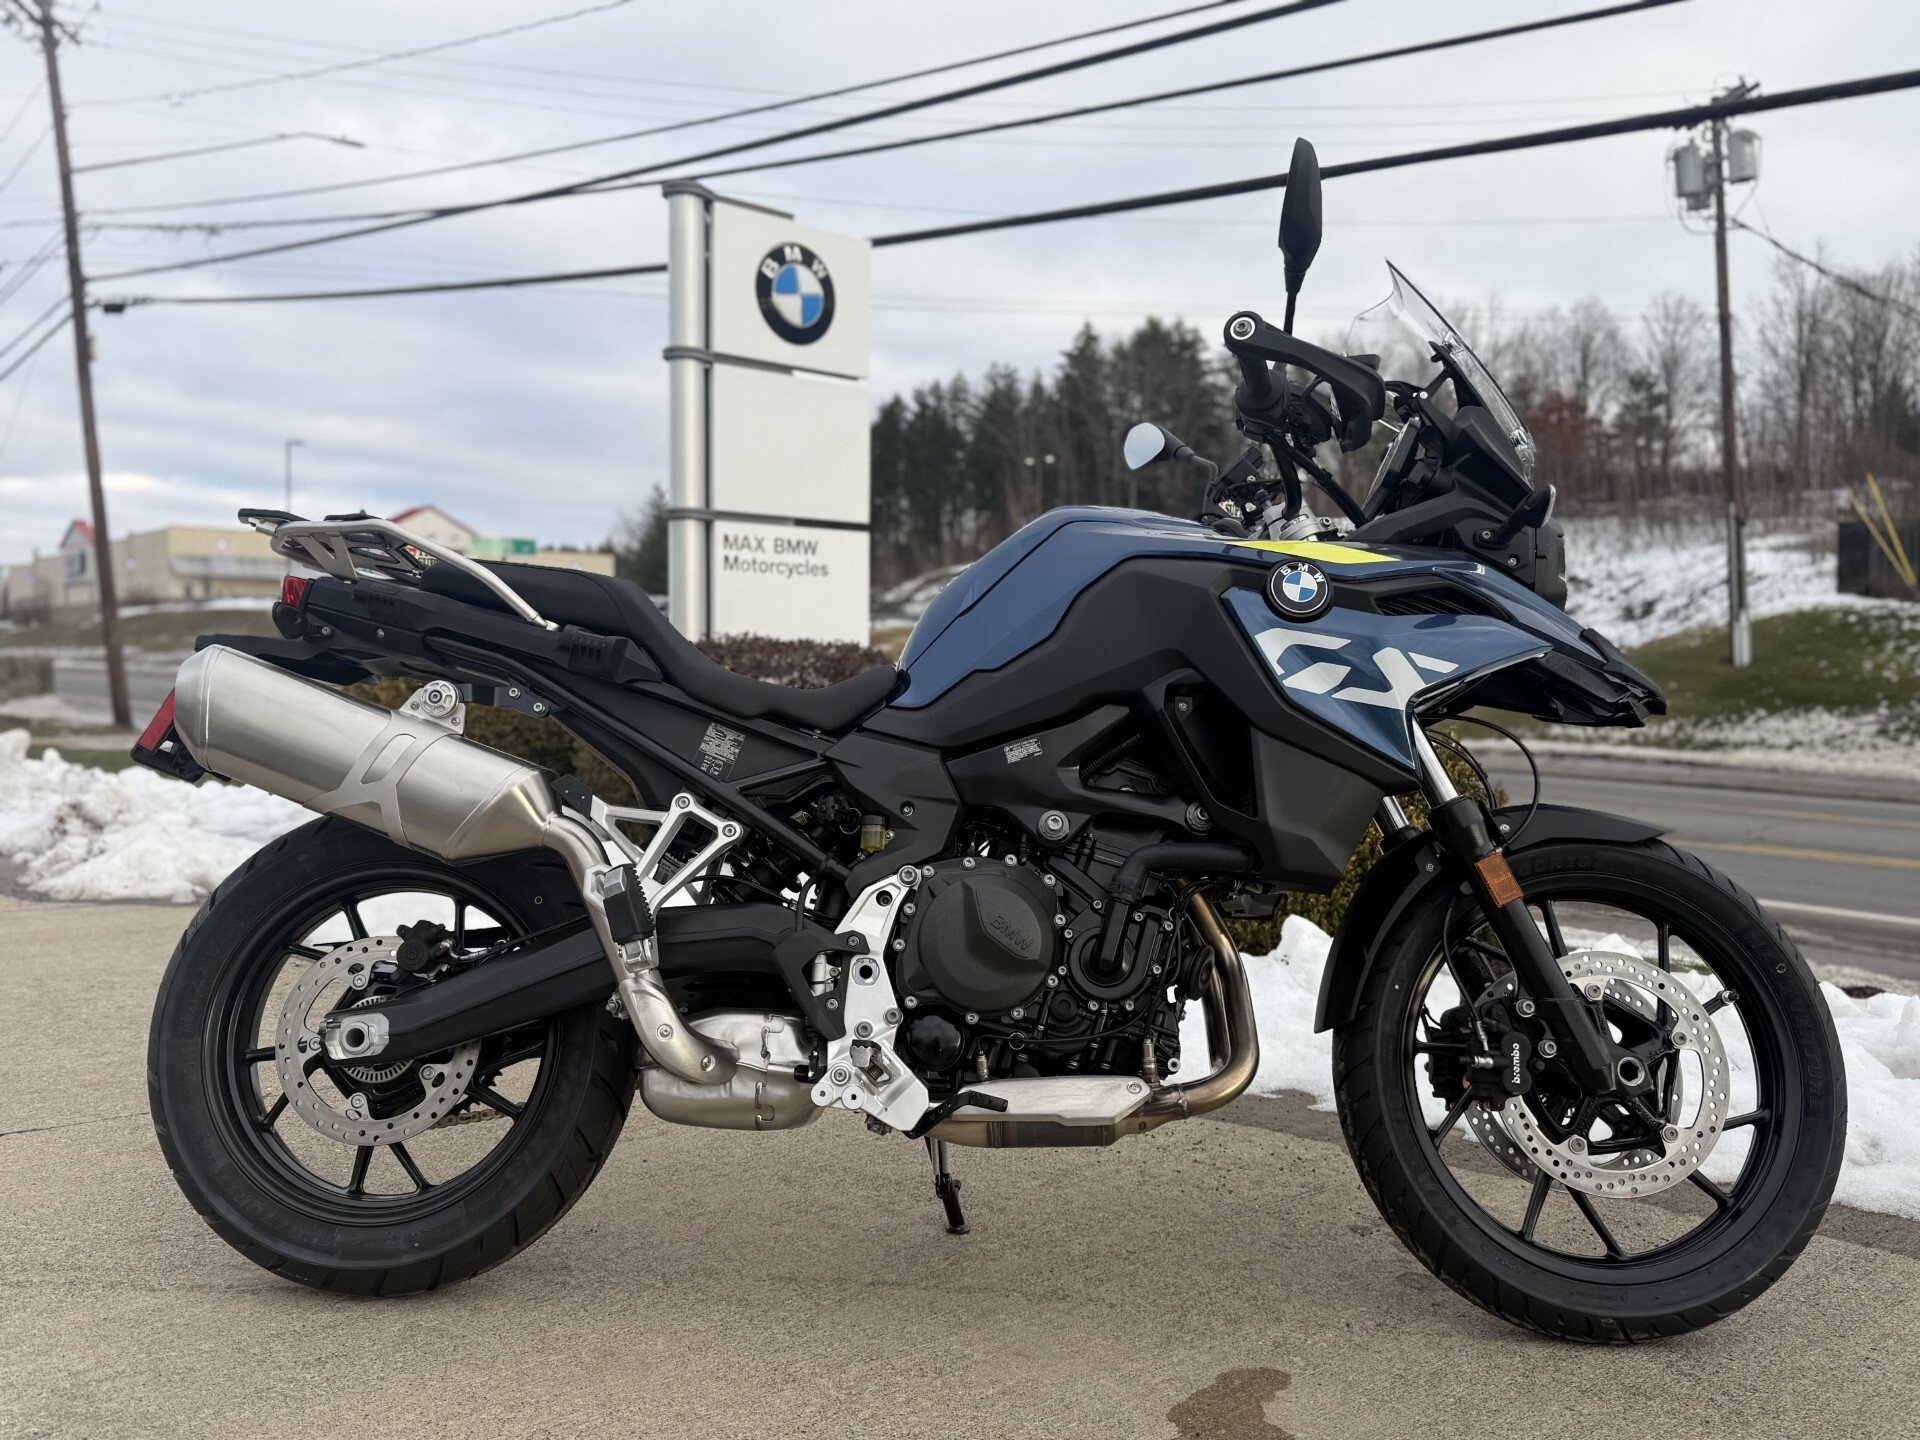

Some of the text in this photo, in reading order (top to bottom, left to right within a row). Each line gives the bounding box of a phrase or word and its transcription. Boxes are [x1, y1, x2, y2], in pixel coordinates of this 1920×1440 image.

[761, 244, 829, 279] BMW
[723, 534, 819, 556] MAX BMW
[723, 555, 829, 579] Motorcycles
[1281, 563, 1325, 583] BMW
[990, 915, 1034, 951] BMW
[1510, 1043, 1520, 1084] brembo
